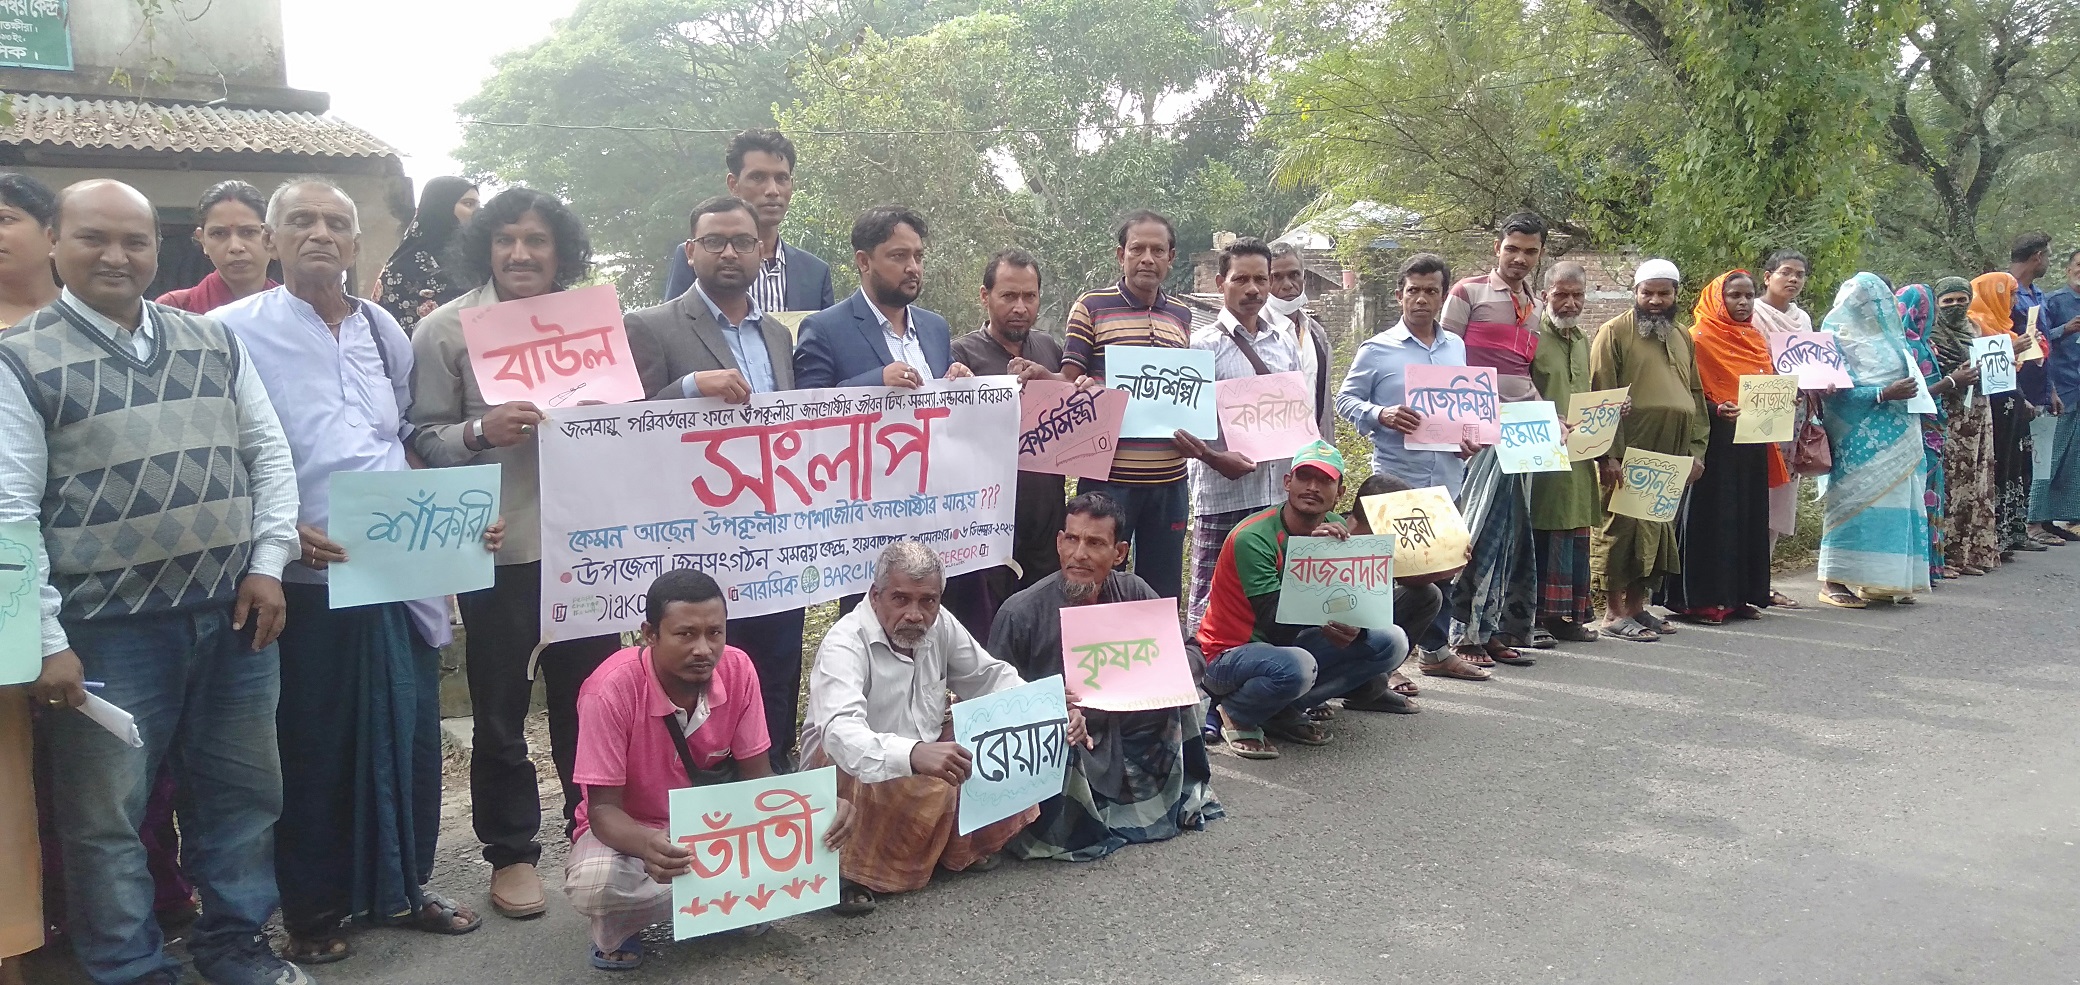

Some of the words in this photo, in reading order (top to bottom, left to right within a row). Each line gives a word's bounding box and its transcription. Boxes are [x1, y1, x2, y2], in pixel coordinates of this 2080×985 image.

[483, 315, 617, 390] বাউল
[1777, 335, 1841, 373] আদিবাসী
[560, 416, 622, 439] জলবায়ু
[628, 410, 699, 433] পরিবর্তনের
[703, 408, 734, 426] ফলে
[739, 399, 797, 425] উপকূলীয়
[800, 395, 853, 419] জনগোষ্ঠীর
[855, 394, 883, 415] জীবন
[978, 384, 1013, 405] বিষয়ক
[1225, 388, 1313, 435] কবিরাজ
[1500, 420, 1551, 448] কুমার
[680, 406, 951, 514] সংলাপ
[1627, 465, 1673, 497] ভ্যান
[568, 525, 628, 552] কেমন
[633, 519, 698, 544] আছেন
[702, 510, 791, 540] উপকূলীয়
[868, 491, 938, 520] জনগোষ্ঠীর
[943, 491, 979, 513] মানুষ
[1393, 508, 1436, 550] ডুবুরী
[572, 553, 664, 585] উপজেলা
[672, 546, 774, 574] জনসংগঠন
[777, 543, 818, 565] সমন্বয়
[737, 570, 799, 601] বারসিক
[1289, 554, 1393, 590] বাজনদার
[1071, 638, 1160, 690] কৃষক
[971, 717, 1068, 782] বেয়ারা
[677, 788, 825, 879] তাঁতী
